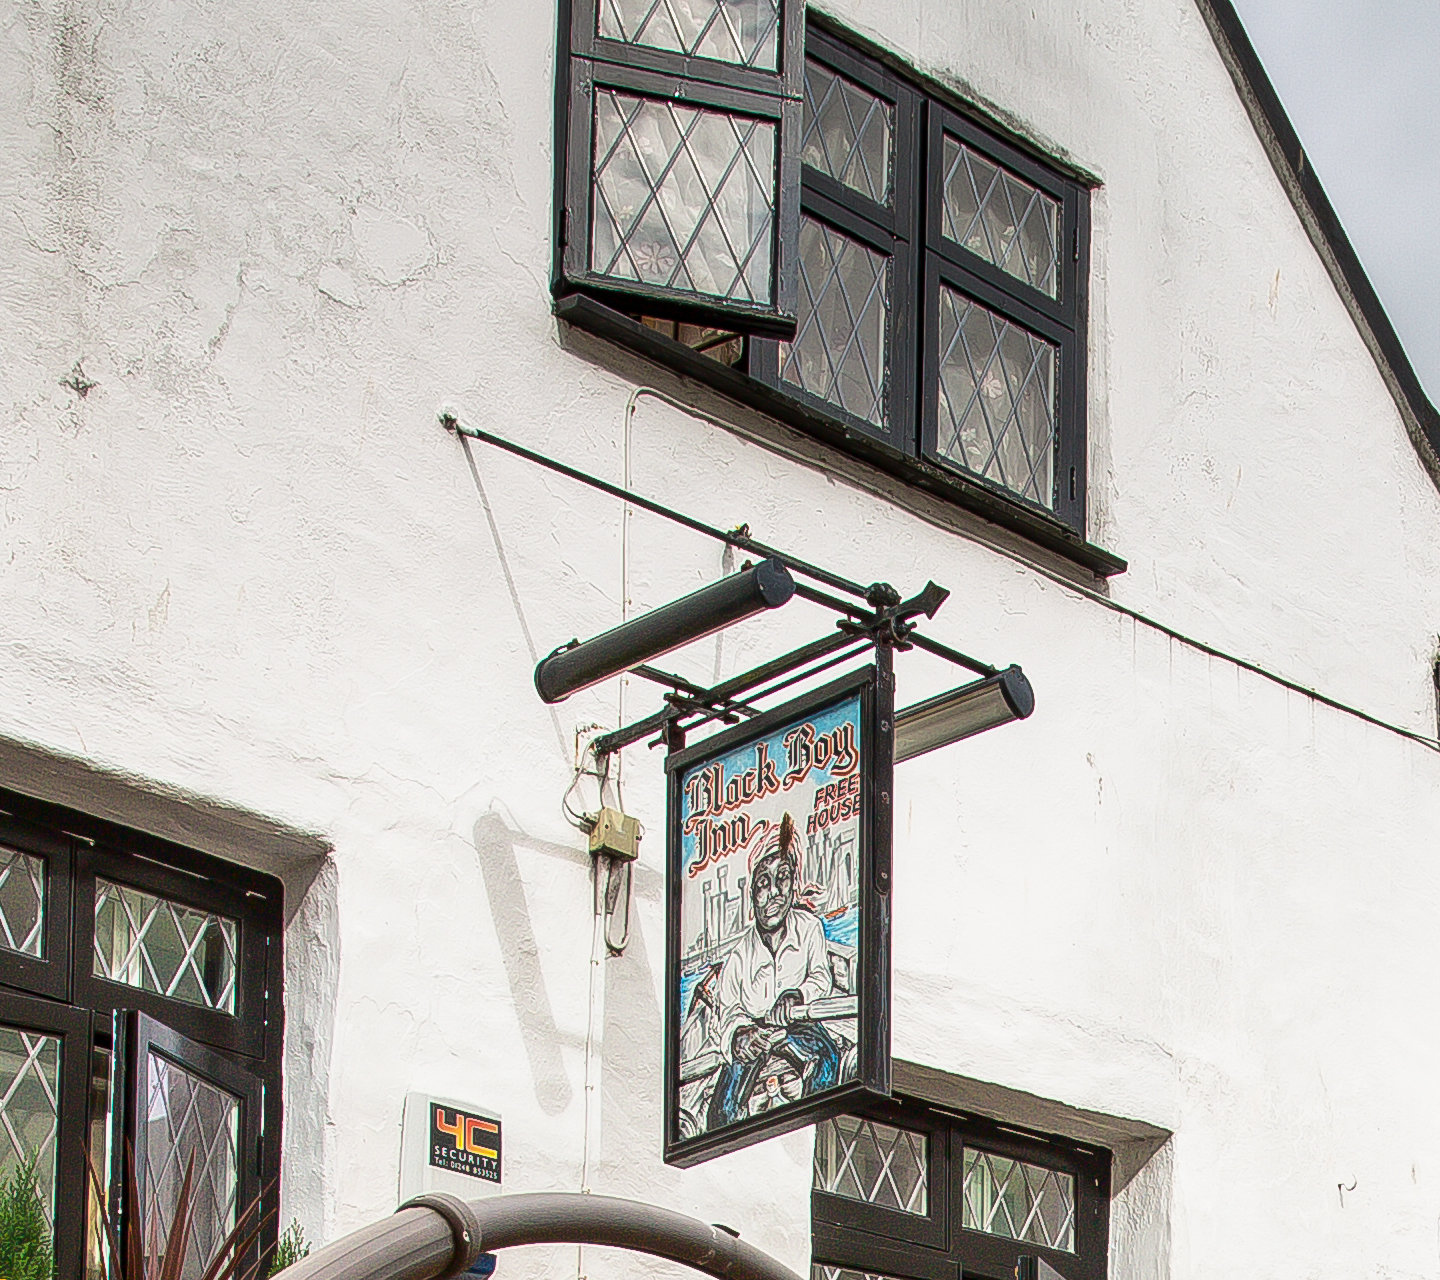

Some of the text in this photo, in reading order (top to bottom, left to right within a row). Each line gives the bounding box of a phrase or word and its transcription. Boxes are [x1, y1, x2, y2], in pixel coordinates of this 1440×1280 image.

[684, 722, 859, 835] Black Boy
[814, 773, 860, 810] FREE
[806, 794, 860, 834] HOUSE
[689, 813, 769, 878] Inn
[437, 1109, 498, 1159] 4C
[434, 1145, 498, 1170] SECURITY
